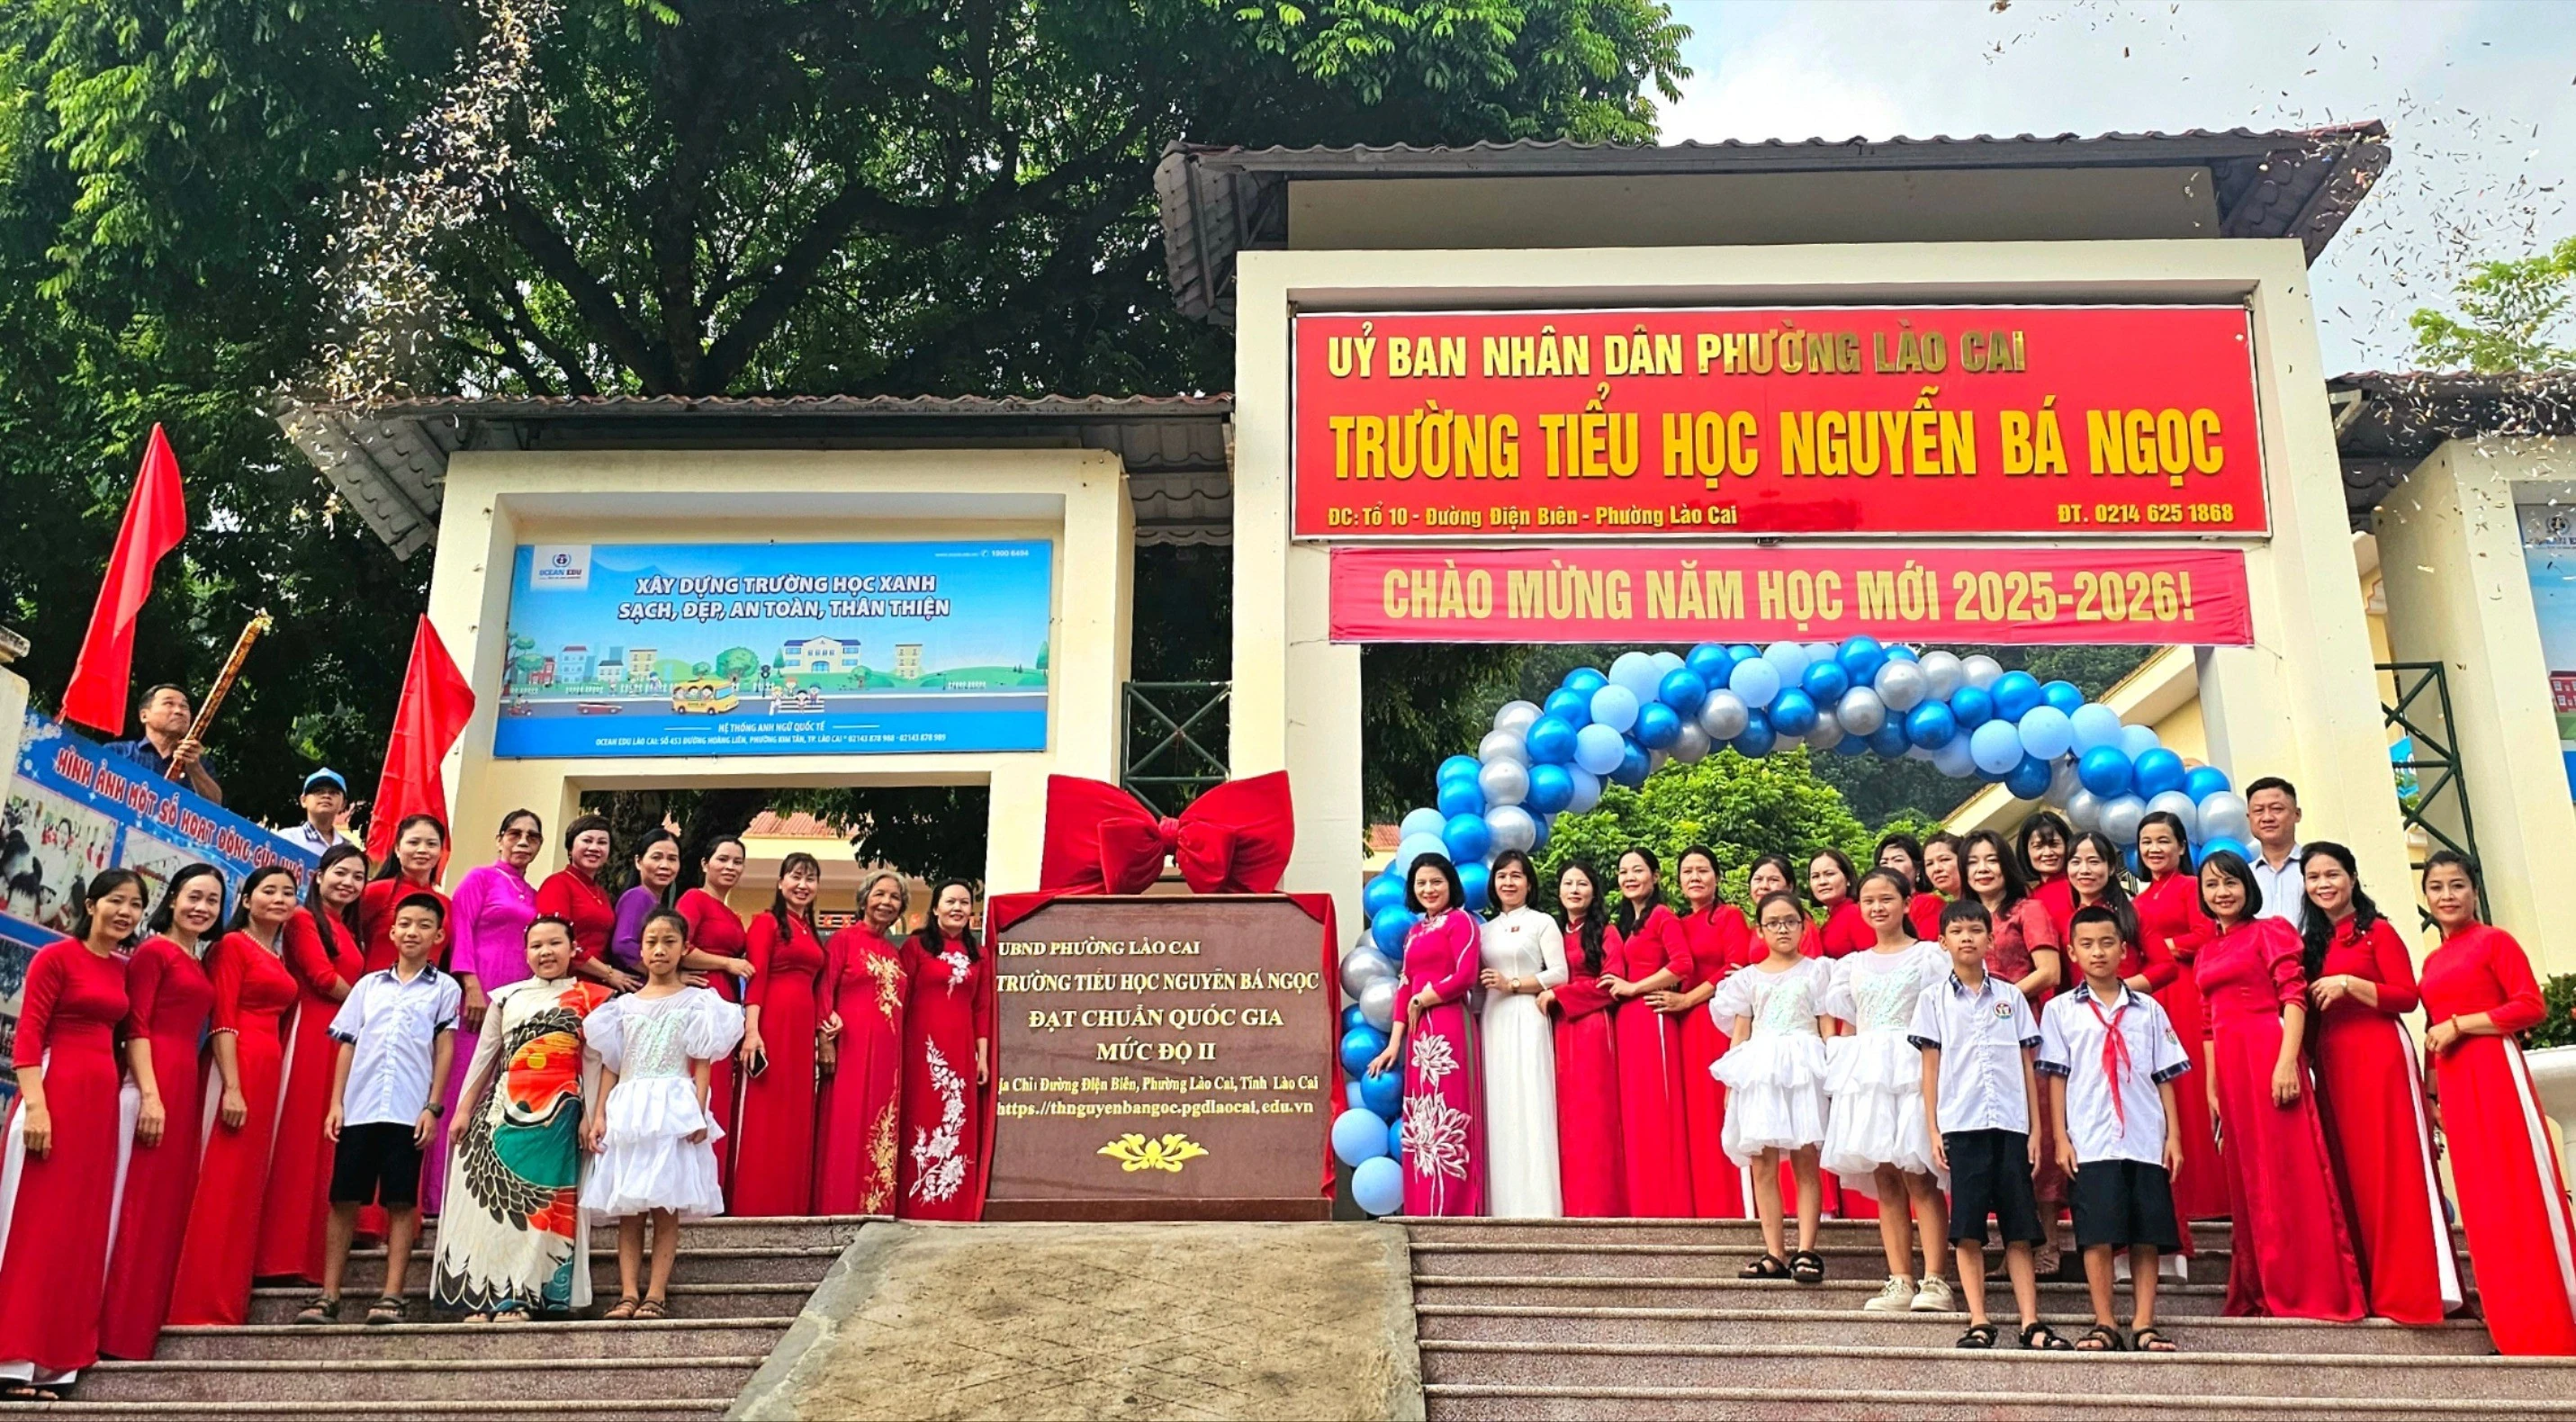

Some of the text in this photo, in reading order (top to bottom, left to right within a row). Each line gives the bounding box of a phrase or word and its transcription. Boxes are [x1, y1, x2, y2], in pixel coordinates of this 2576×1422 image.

[1388, 337, 1466, 378] BAN
[1483, 326, 1590, 377] NHÂN
[1604, 324, 1682, 375] DÂN
[1698, 319, 1860, 374] PHƯỜNG
[1874, 319, 1948, 372] LÀO
[1960, 330, 2025, 371] CAI
[1329, 382, 2224, 490] TRƯỜNG TIỂU HỌC NGUYỄN BÁ NGỌC
[1328, 508, 1358, 526] ĐC:
[1362, 501, 1383, 526] Tổ
[1389, 508, 1408, 526] 10
[1425, 506, 1482, 528] Đường
[1490, 507, 1530, 531] Điện
[1537, 507, 1578, 526] Biên
[1596, 506, 1663, 528] Phường
[1670, 502, 1702, 525] Lào
[1708, 505, 1737, 525] Cai
[2058, 504, 2233, 523] ĐT. 0214 625 1868
[635, 573, 936, 599] XÂY DỰNG TRƯỜNG HỌC XANH
[1383, 559, 2194, 632] CHÀO MỪNG NĂM HỌC MỚI 2025-2026!
[618, 596, 950, 624] SẠCH, ĐẸP, AN TOÀN, THÂN THIỆN
[595, 738, 617, 746] OCEAN
[618, 737, 631, 745] EDU
[633, 736, 645, 745] LÀO
[718, 720, 826, 734] HỆ THỐNG ANH NGỮ QUỐC TẾ
[55, 744, 94, 788] HÌNH
[94, 759, 126, 804] ẢNH
[128, 781, 158, 818] MỘT
[158, 792, 180, 827] SỐ
[180, 808, 216, 844] HOẠT
[217, 825, 251, 862] ĐỘNG
[998, 936, 1201, 956] UBND PHƯỜNG LÀO CAI
[996, 967, 1320, 994] TRƯỜNG TIỂU HỌC NGUYỄN BÁ NGỌC
[1028, 1009, 1076, 1033] ĐẠT
[1081, 1004, 1164, 1027] CHUẨN
[1241, 1009, 1284, 1026] GIA
[1096, 1036, 1217, 1065] MỨC ĐỘ II
[1040, 1076, 1079, 1094] Đường
[1081, 1076, 1108, 1094] Điện
[1111, 1076, 1139, 1093] Biên,
[1142, 1076, 1187, 1094] Phường
[1189, 1076, 1211, 1090] Lào
[1273, 1076, 1296, 1090] Lào
[1298, 1075, 1319, 1090] Cai
